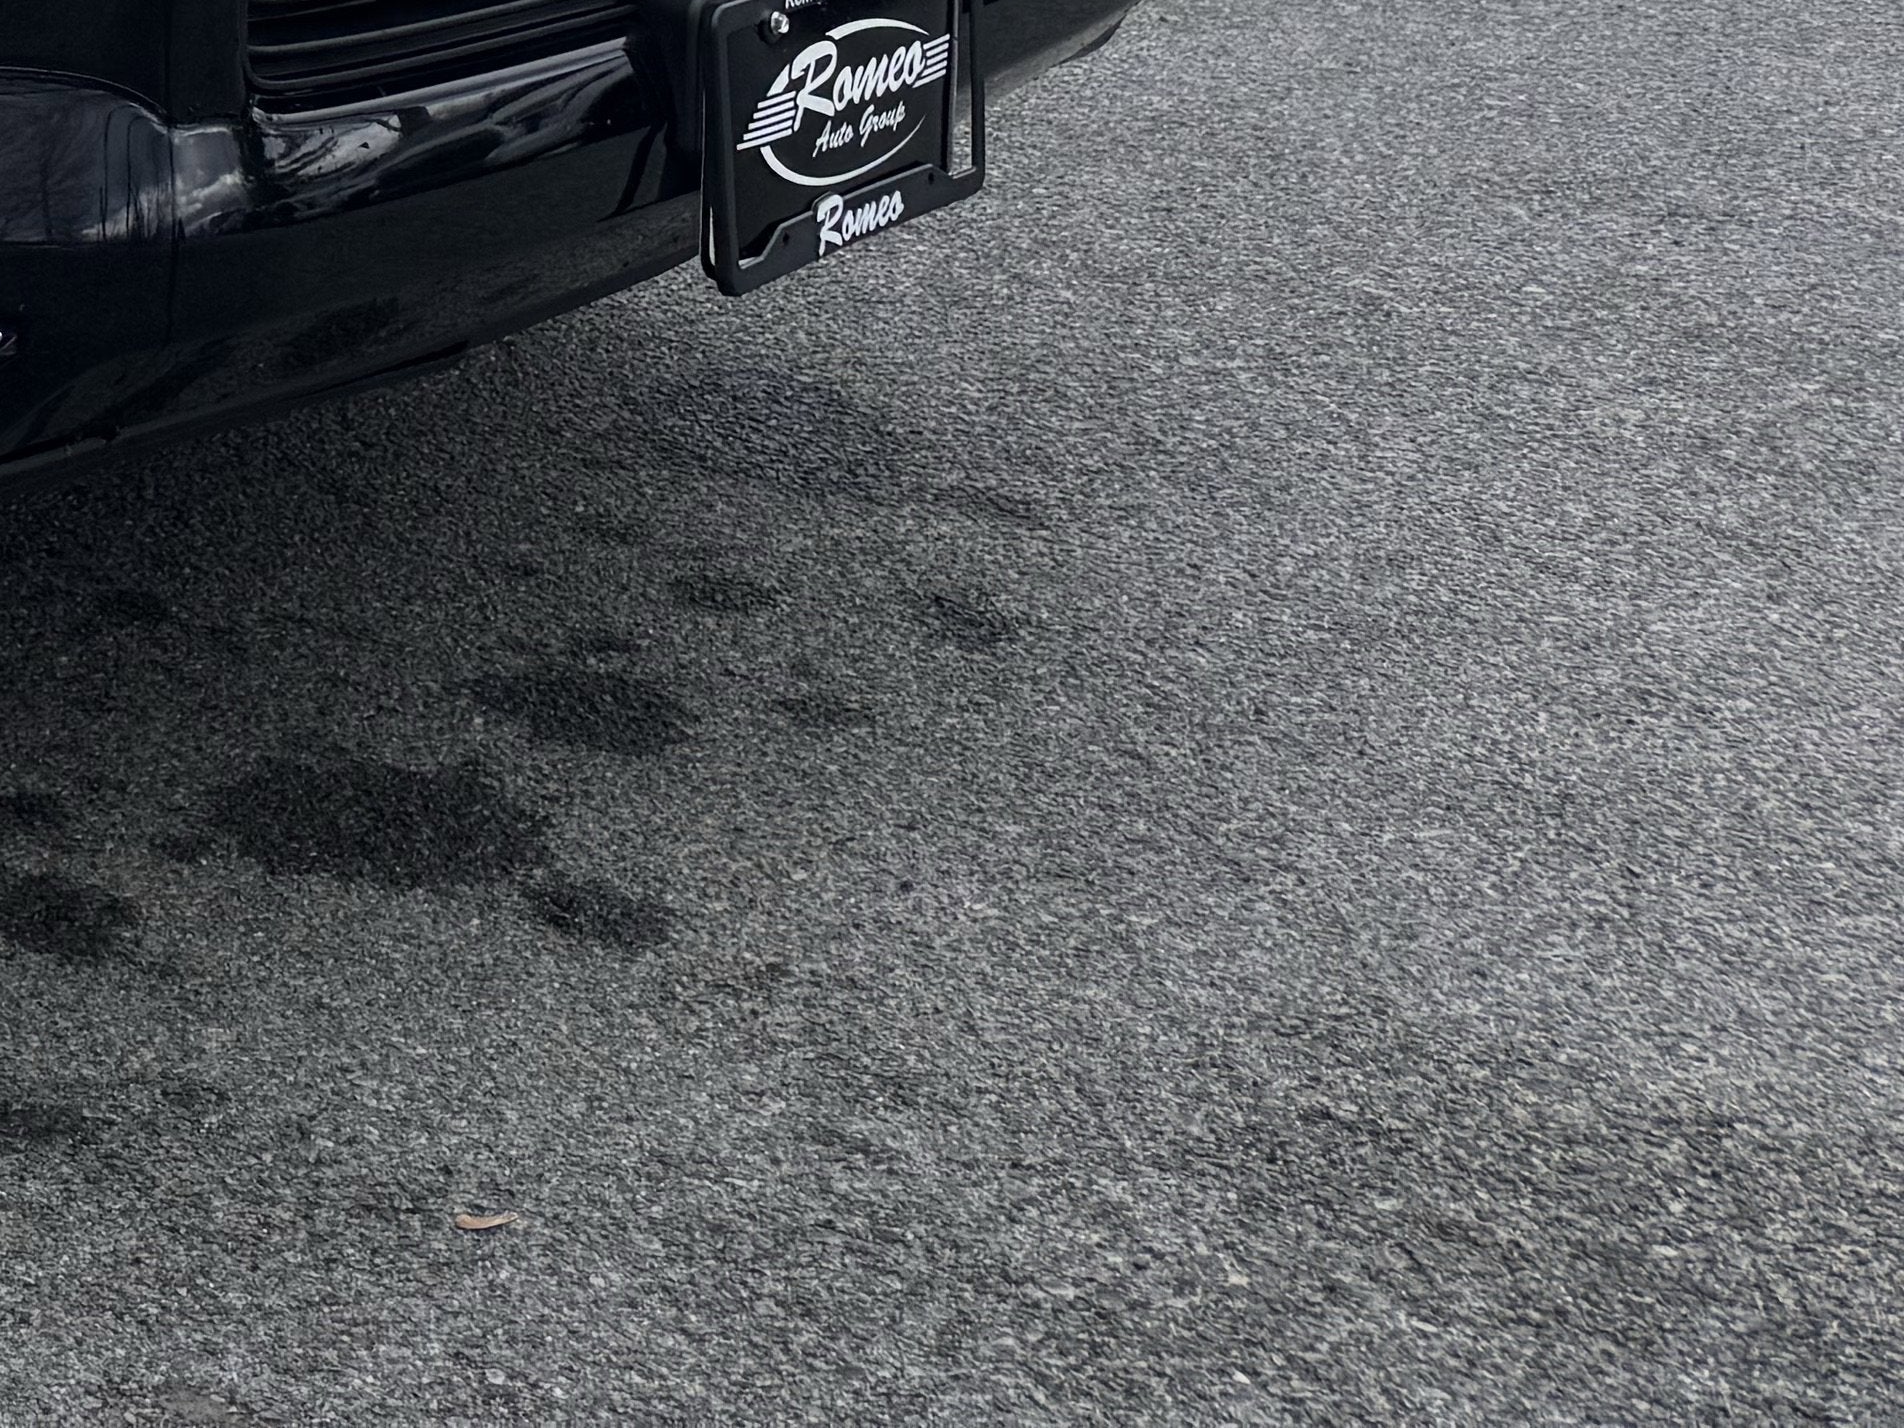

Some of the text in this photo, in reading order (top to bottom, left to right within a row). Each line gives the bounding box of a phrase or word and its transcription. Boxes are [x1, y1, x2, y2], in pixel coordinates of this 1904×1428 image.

[791, 40, 926, 132] Romeo
[812, 100, 906, 157] Auto Group
[816, 190, 904, 256] Romeo
